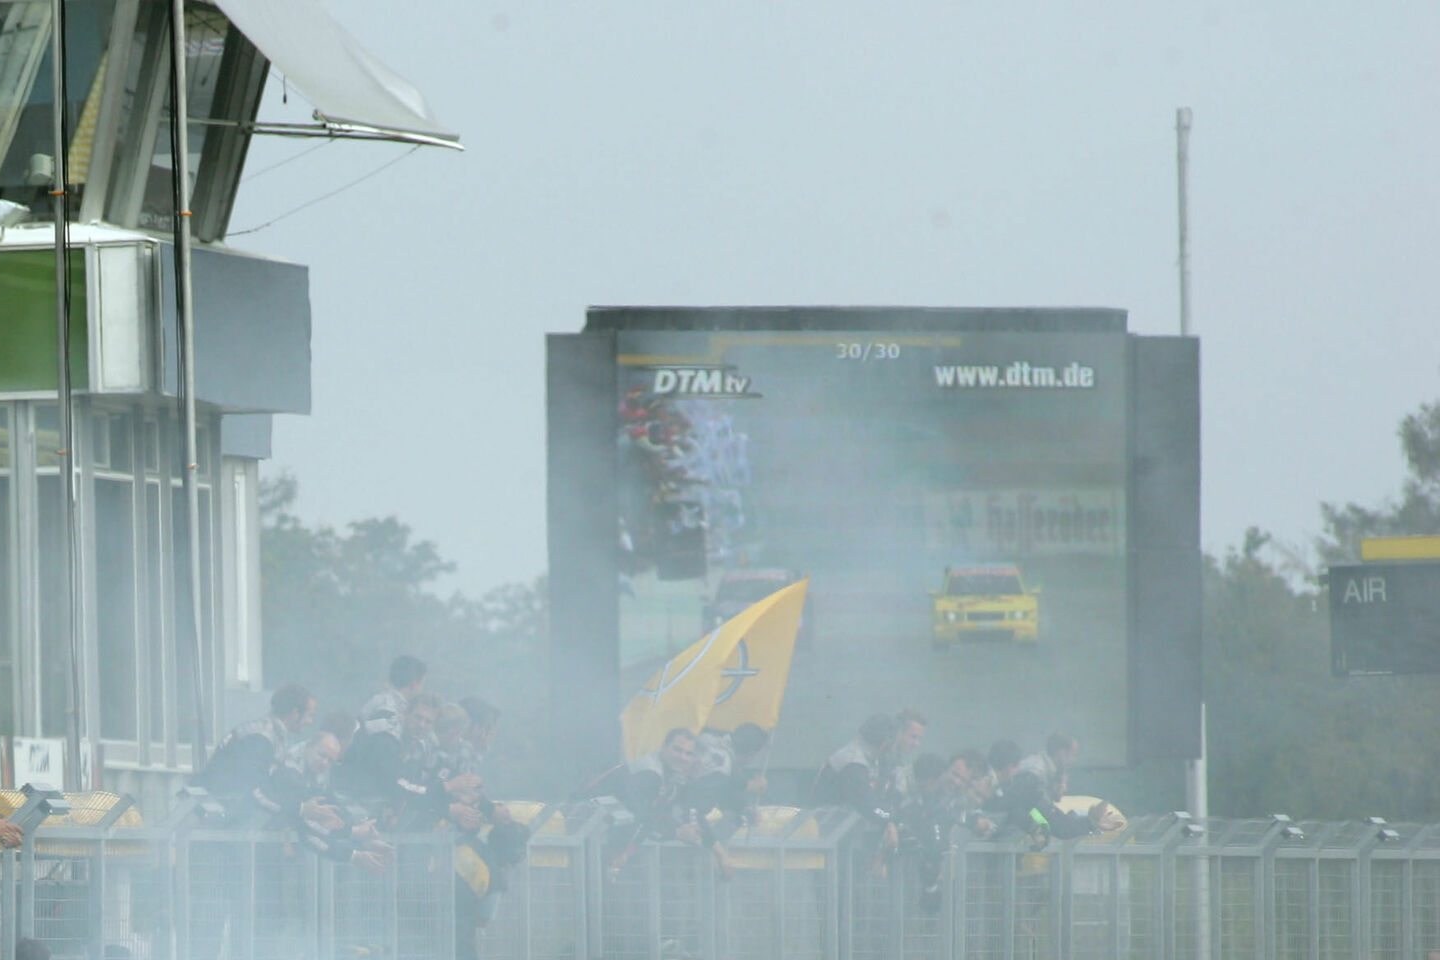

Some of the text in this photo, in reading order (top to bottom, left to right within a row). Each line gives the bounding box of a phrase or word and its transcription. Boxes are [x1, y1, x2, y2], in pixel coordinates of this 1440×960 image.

[836, 343, 901, 362] 30/30
[933, 361, 1094, 387] www.dtm.de
[1344, 577, 1387, 603] AIR
